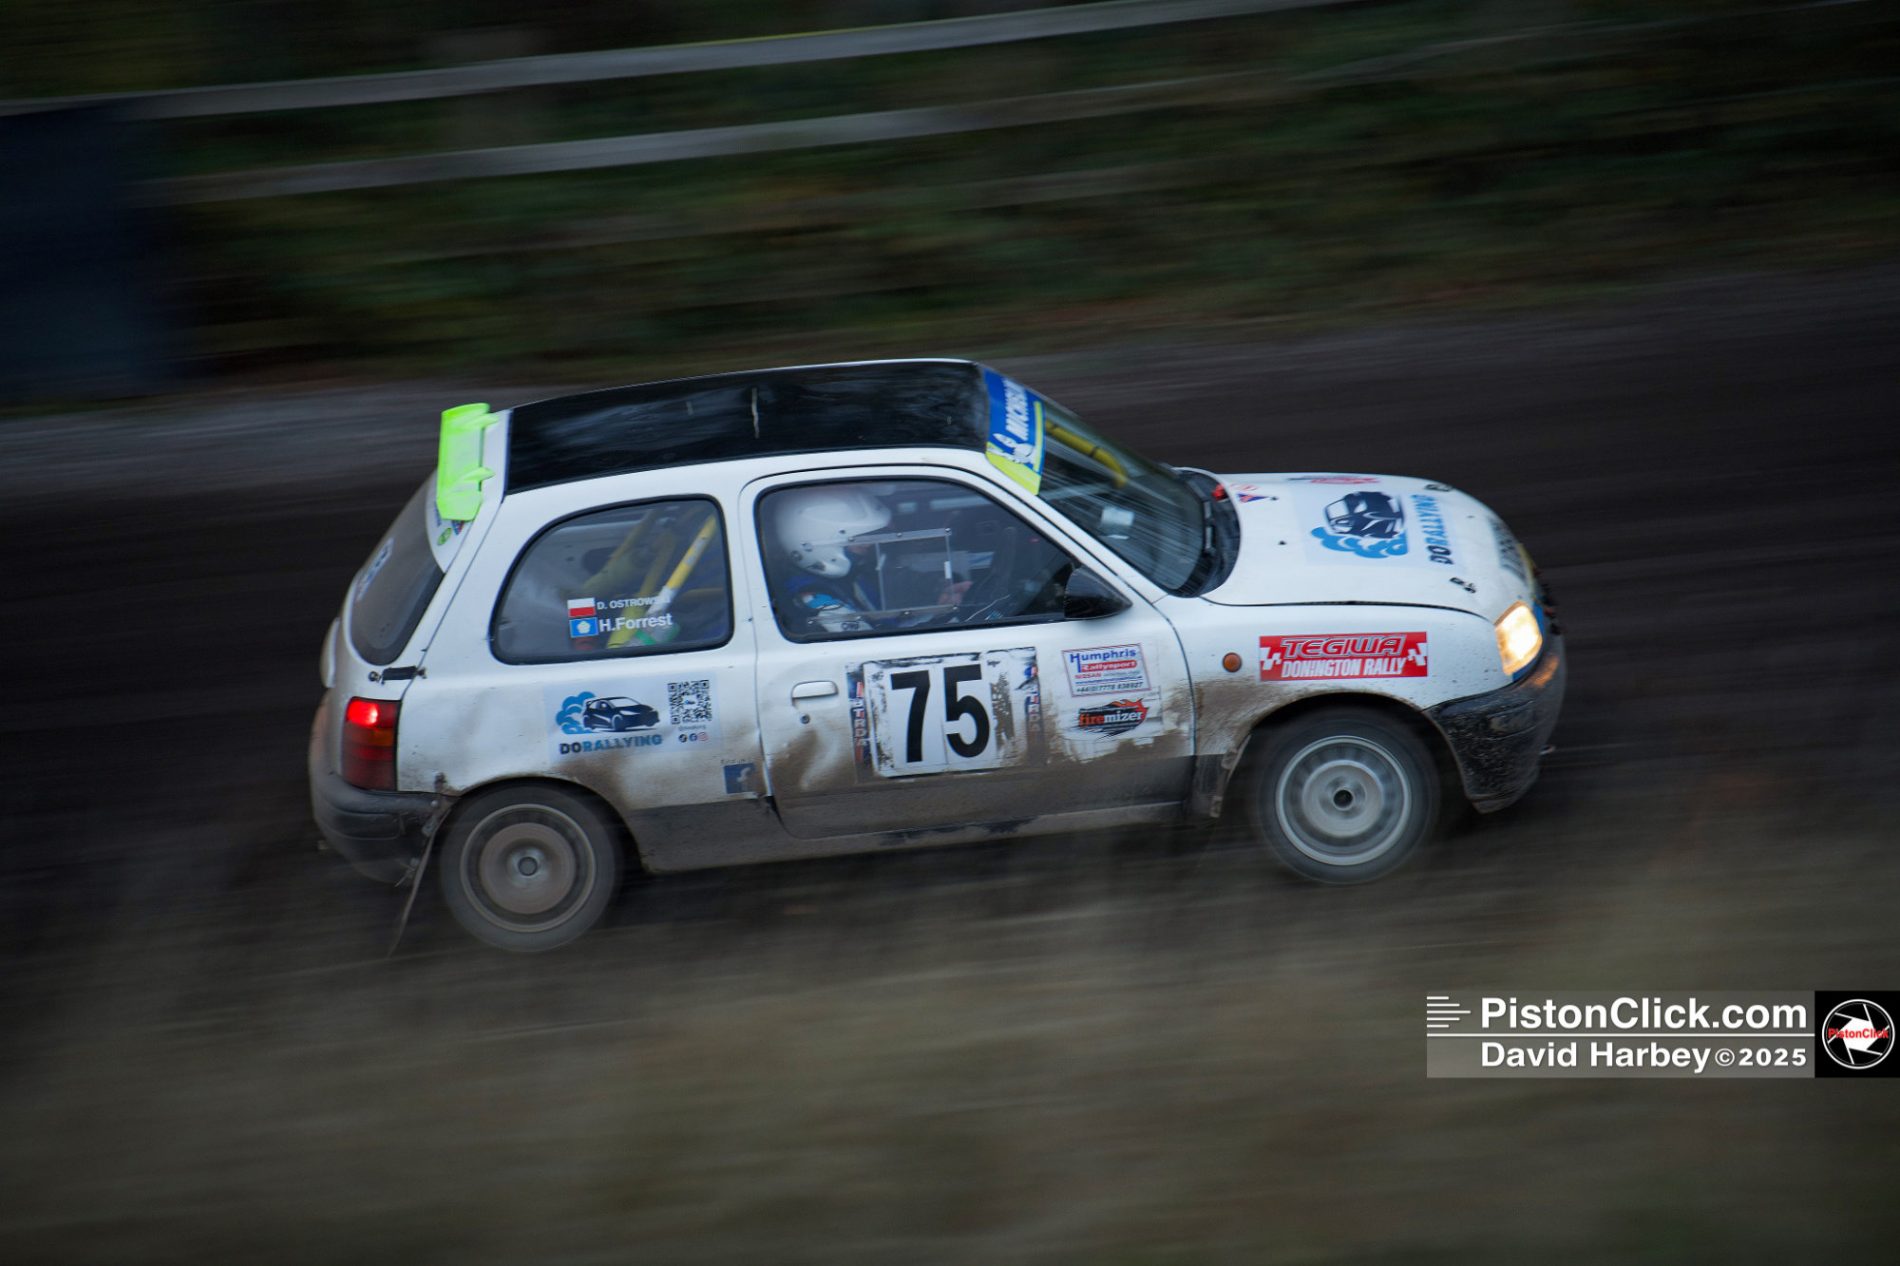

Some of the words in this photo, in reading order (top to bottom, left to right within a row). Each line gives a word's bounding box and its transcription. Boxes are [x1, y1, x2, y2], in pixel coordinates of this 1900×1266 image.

[600, 613, 673, 633] H.Forrest
[1280, 635, 1408, 659] TEGIWA
[1070, 649, 1137, 670] Humphris
[1281, 659, 1361, 678] DONINGTON
[1362, 657, 1407, 675] RALLY
[890, 664, 990, 763] 75
[1079, 711, 1144, 727] firemizer
[559, 734, 663, 755] DORALLYING
